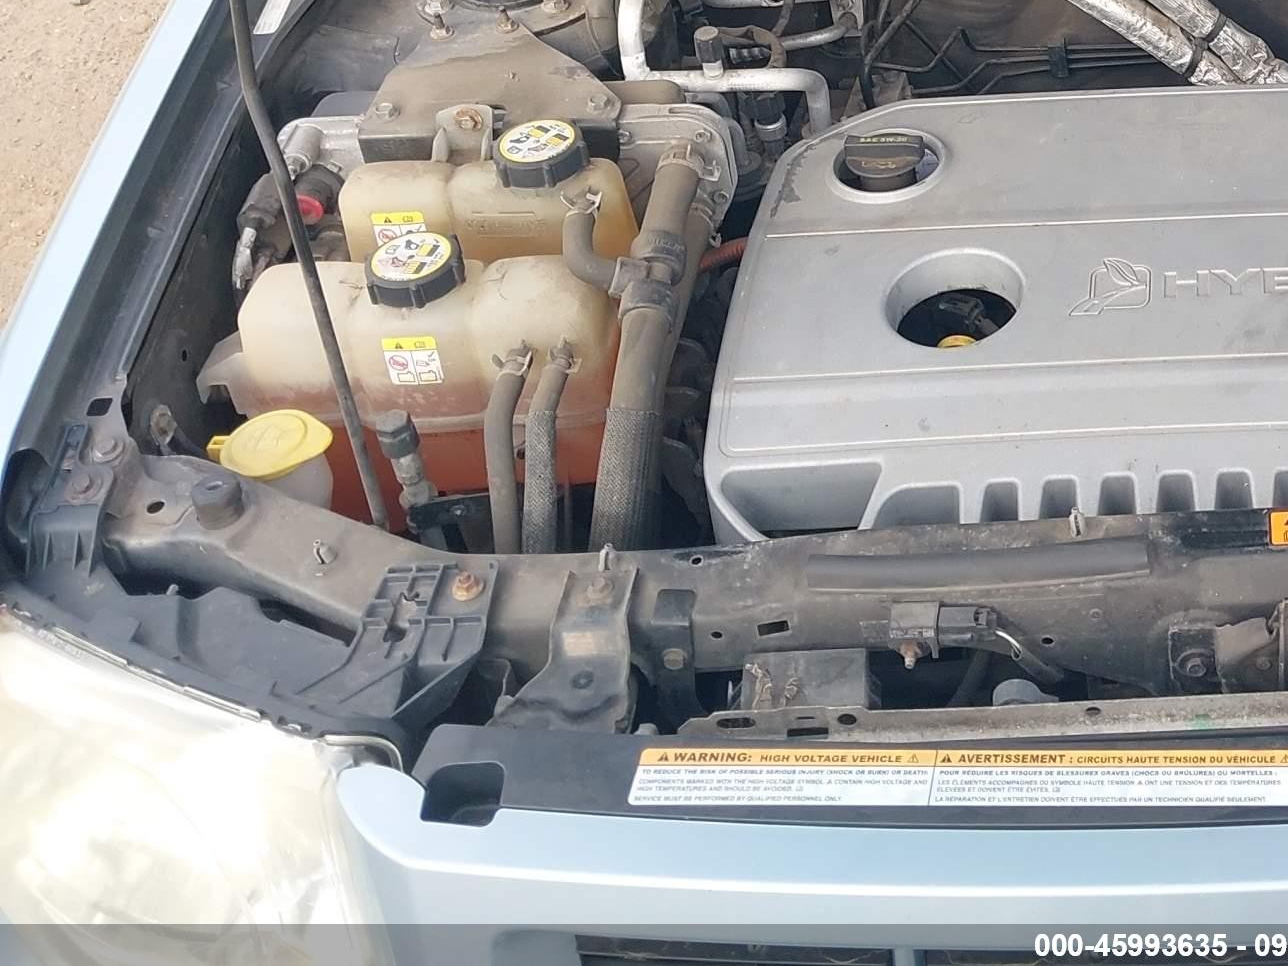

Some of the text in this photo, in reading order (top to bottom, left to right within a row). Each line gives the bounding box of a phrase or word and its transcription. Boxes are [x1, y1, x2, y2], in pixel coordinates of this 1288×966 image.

[673, 752, 902, 763] WARNING: HIGH VOLTAGE VEHICLE
[958, 753, 1065, 764] AVERTISSEMENT
[1076, 755, 1123, 764] CIRCUITS
[1126, 755, 1160, 764] HAUTE
[1163, 755, 1206, 764] TENSION
[1209, 755, 1223, 764] DU
[1227, 754, 1276, 764] VÉHICULE
